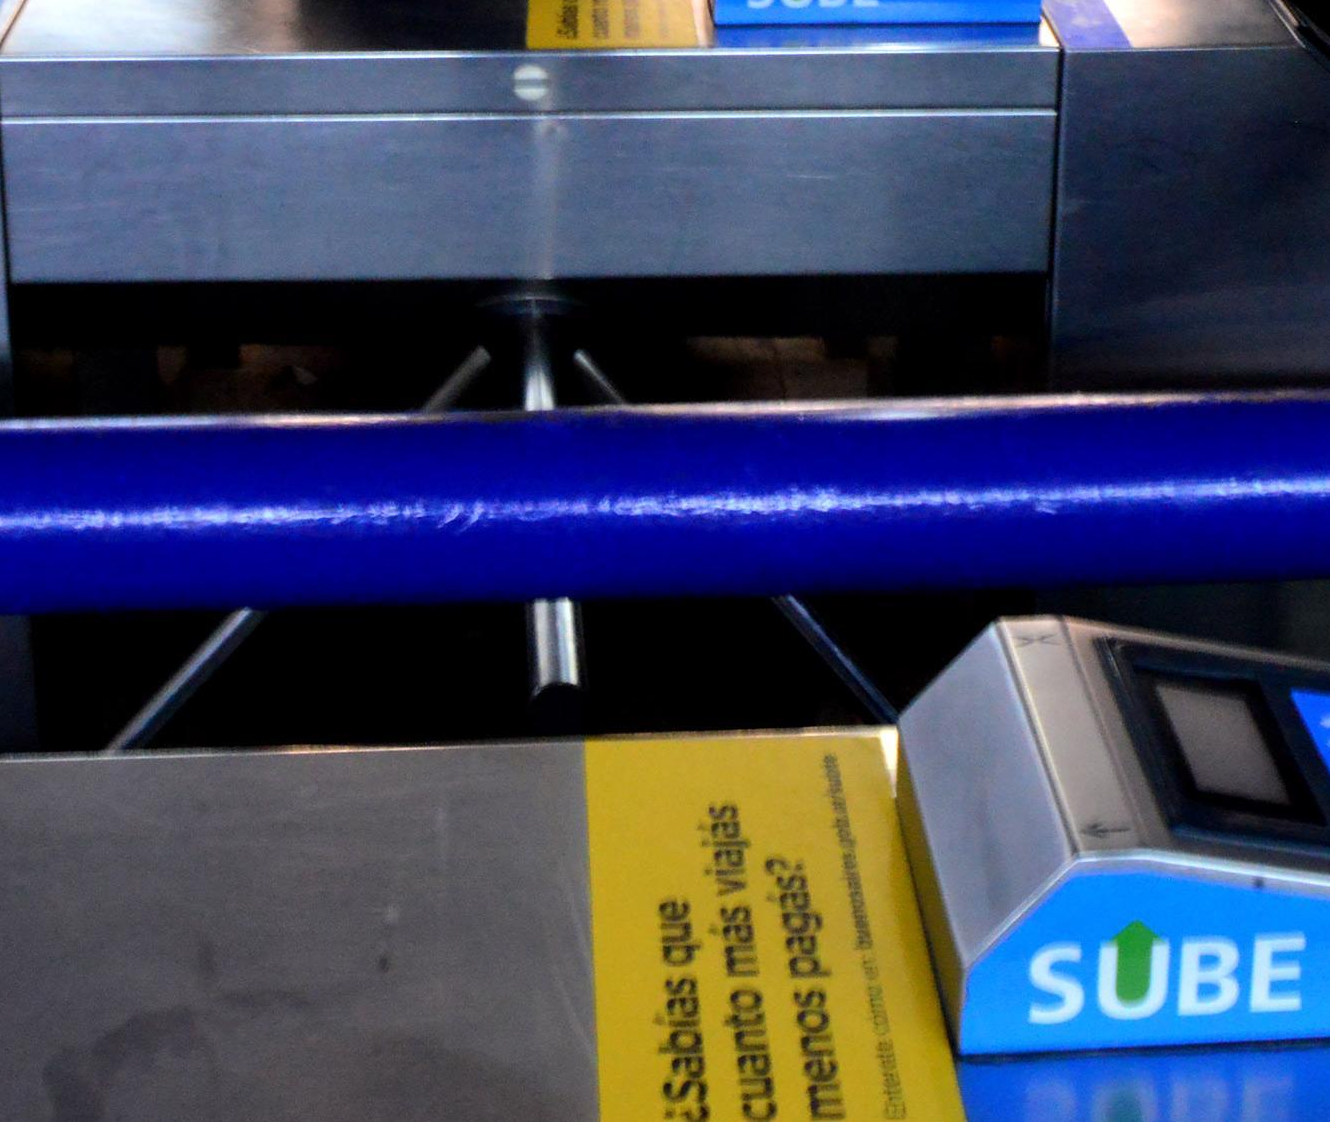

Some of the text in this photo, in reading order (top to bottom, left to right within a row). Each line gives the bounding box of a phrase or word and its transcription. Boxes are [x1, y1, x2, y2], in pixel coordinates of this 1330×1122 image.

[653, 897, 711, 1122] ¿Sabías que
[696, 801, 777, 1121] cuanto más viajás
[764, 855, 847, 1121] menos pagás?
[1027, 930, 1307, 1025] SUBE
